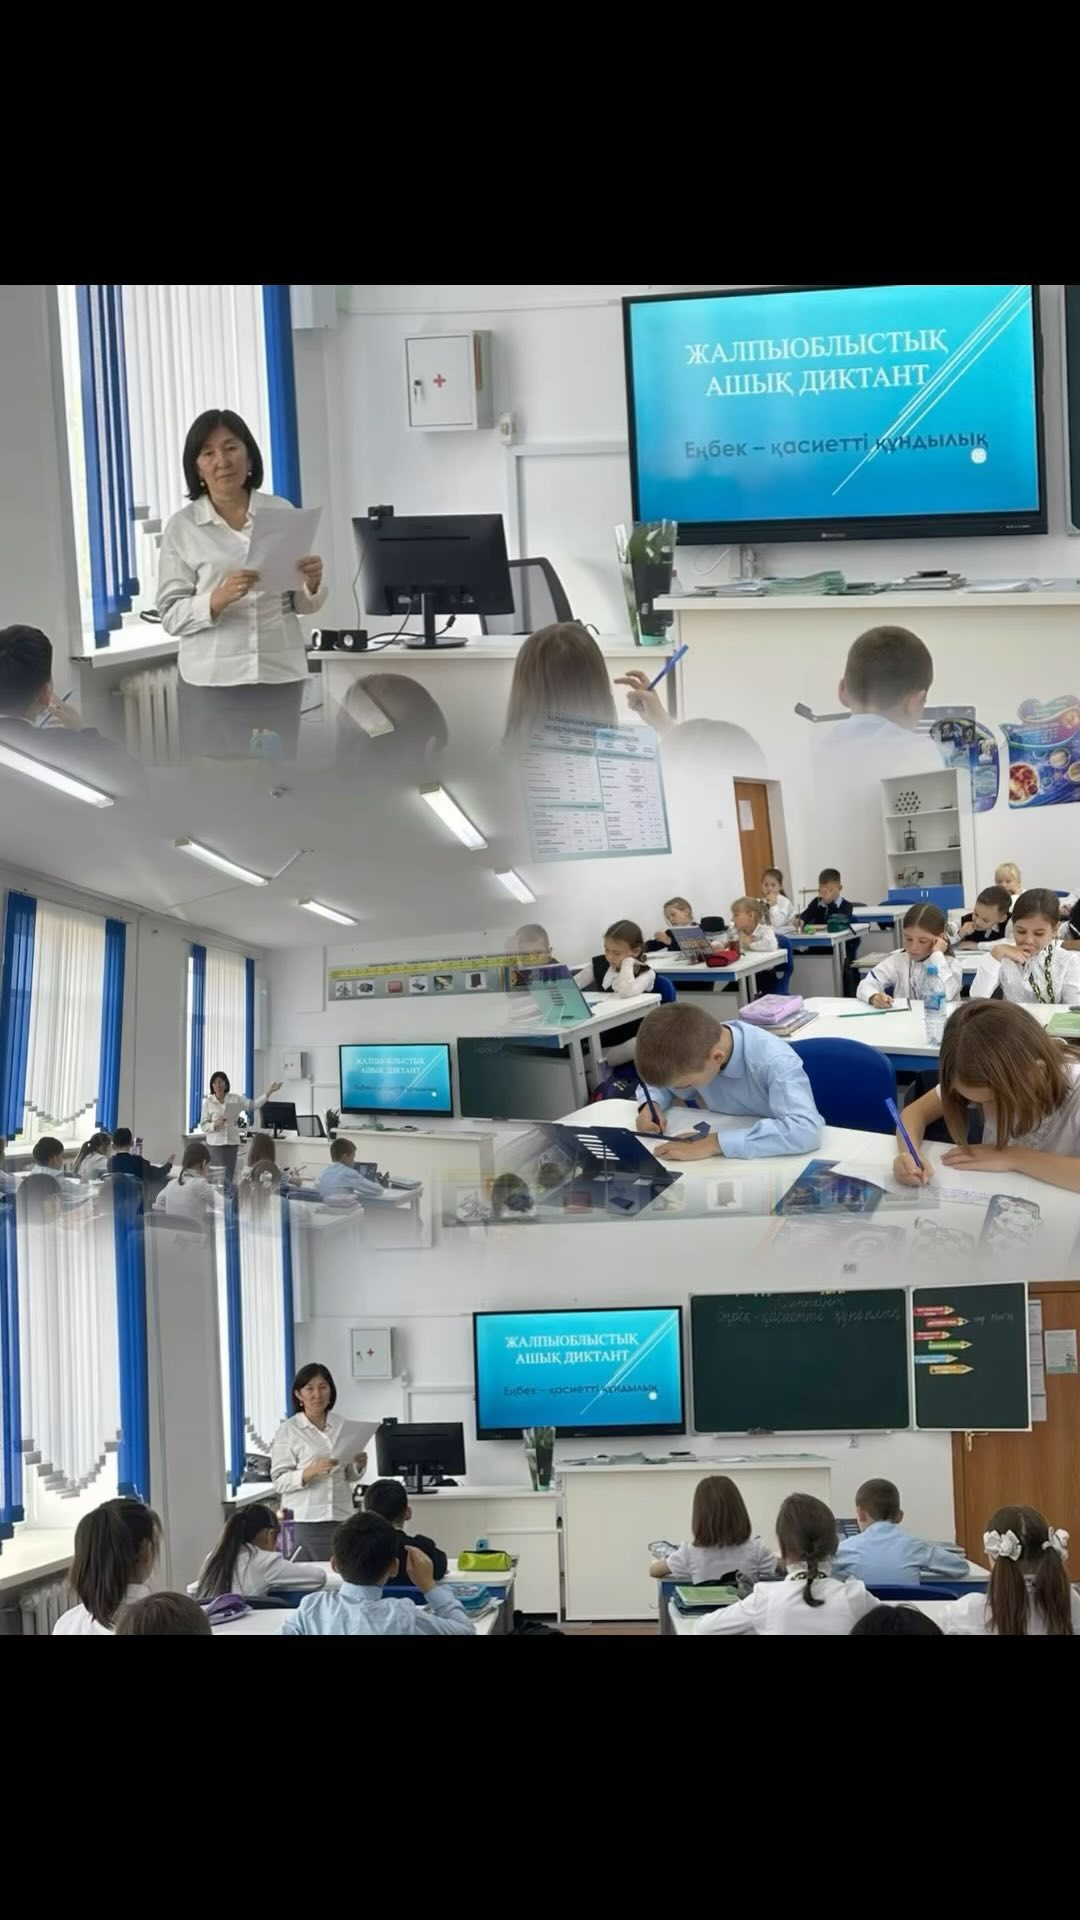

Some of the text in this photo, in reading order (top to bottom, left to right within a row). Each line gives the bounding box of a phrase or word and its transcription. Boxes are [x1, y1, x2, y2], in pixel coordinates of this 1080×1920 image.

[686, 328, 948, 365] ЖАЛПЫОБЛЫСТЫҚ
[705, 363, 930, 397] АШЫҚ ДИКТАНТ
[685, 438, 747, 461] Еңбек
[771, 432, 869, 459] қасиетті
[505, 1333, 639, 1349] ЖАЛПЫОБЛЫСТЫҚ
[516, 1350, 629, 1366] АШЫҚ ДИКТАНТ
